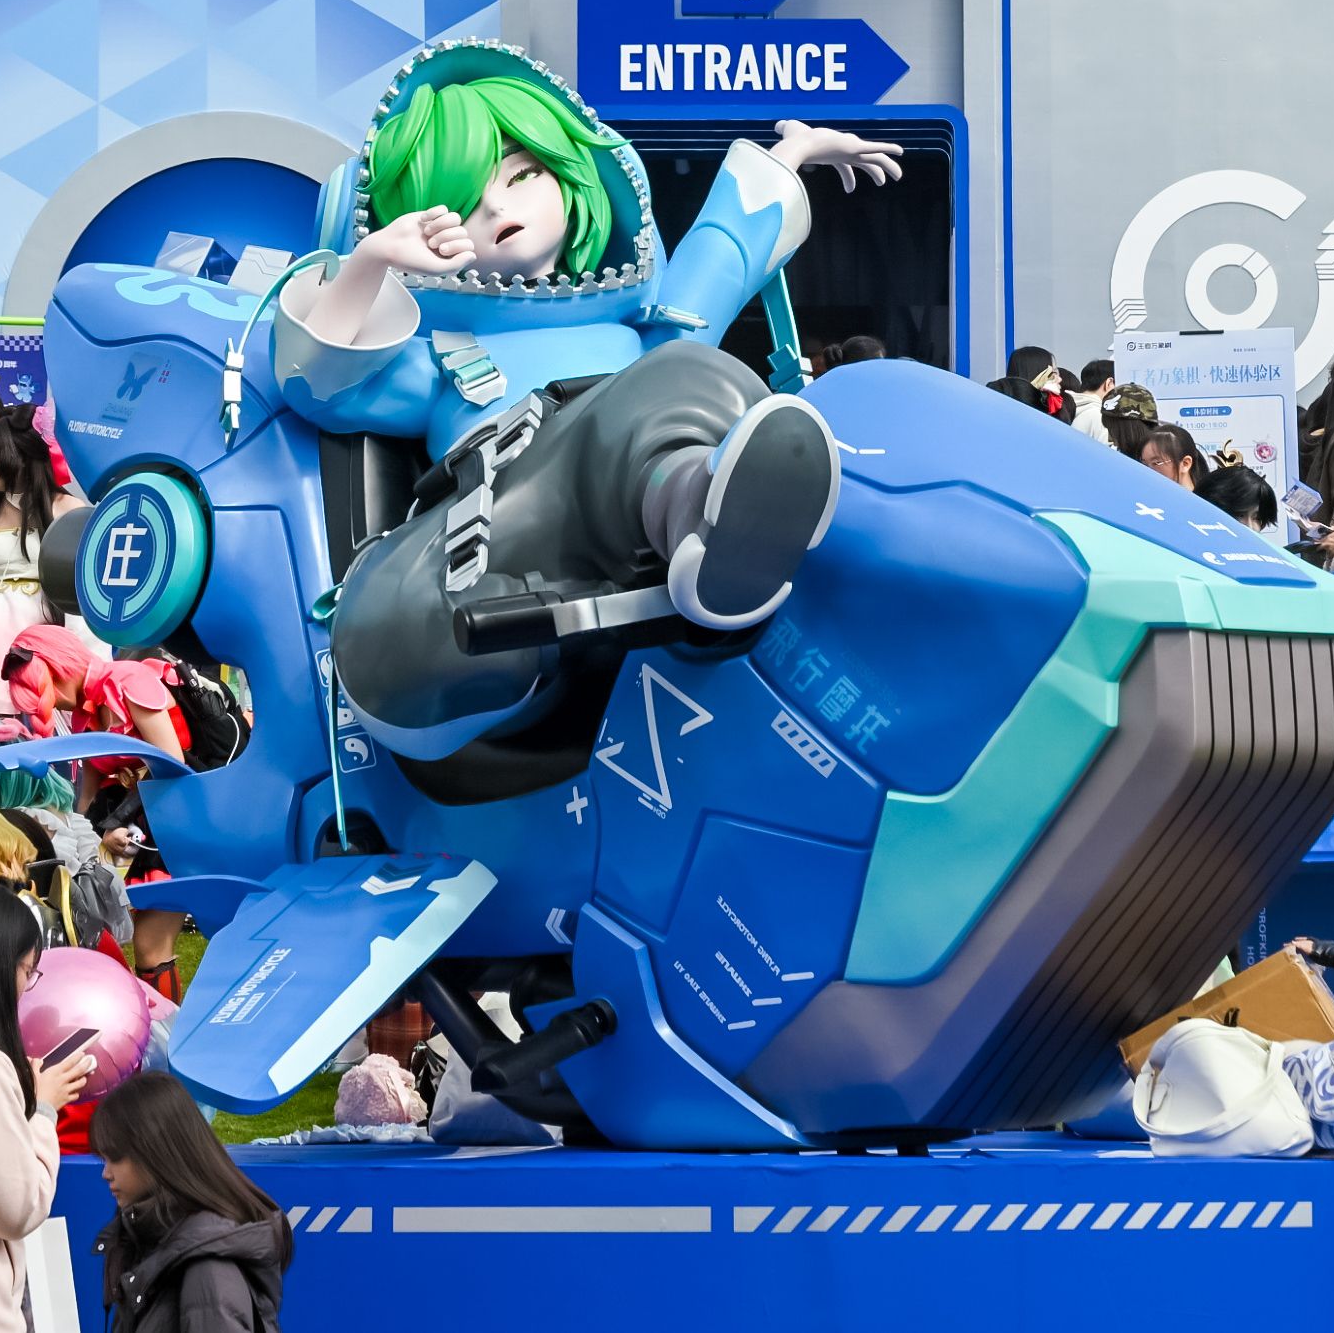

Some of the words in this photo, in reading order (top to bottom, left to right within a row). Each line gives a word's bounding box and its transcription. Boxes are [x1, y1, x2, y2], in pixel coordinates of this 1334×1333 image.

[620, 43, 847, 91] ENTRANCE
[68, 420, 86, 433] FLYING
[86, 423, 124, 439] MOTORCYCLE
[102, 523, 149, 587] 庄
[210, 997, 245, 1023] FLYING
[235, 948, 292, 996] MOTORCYCLE
